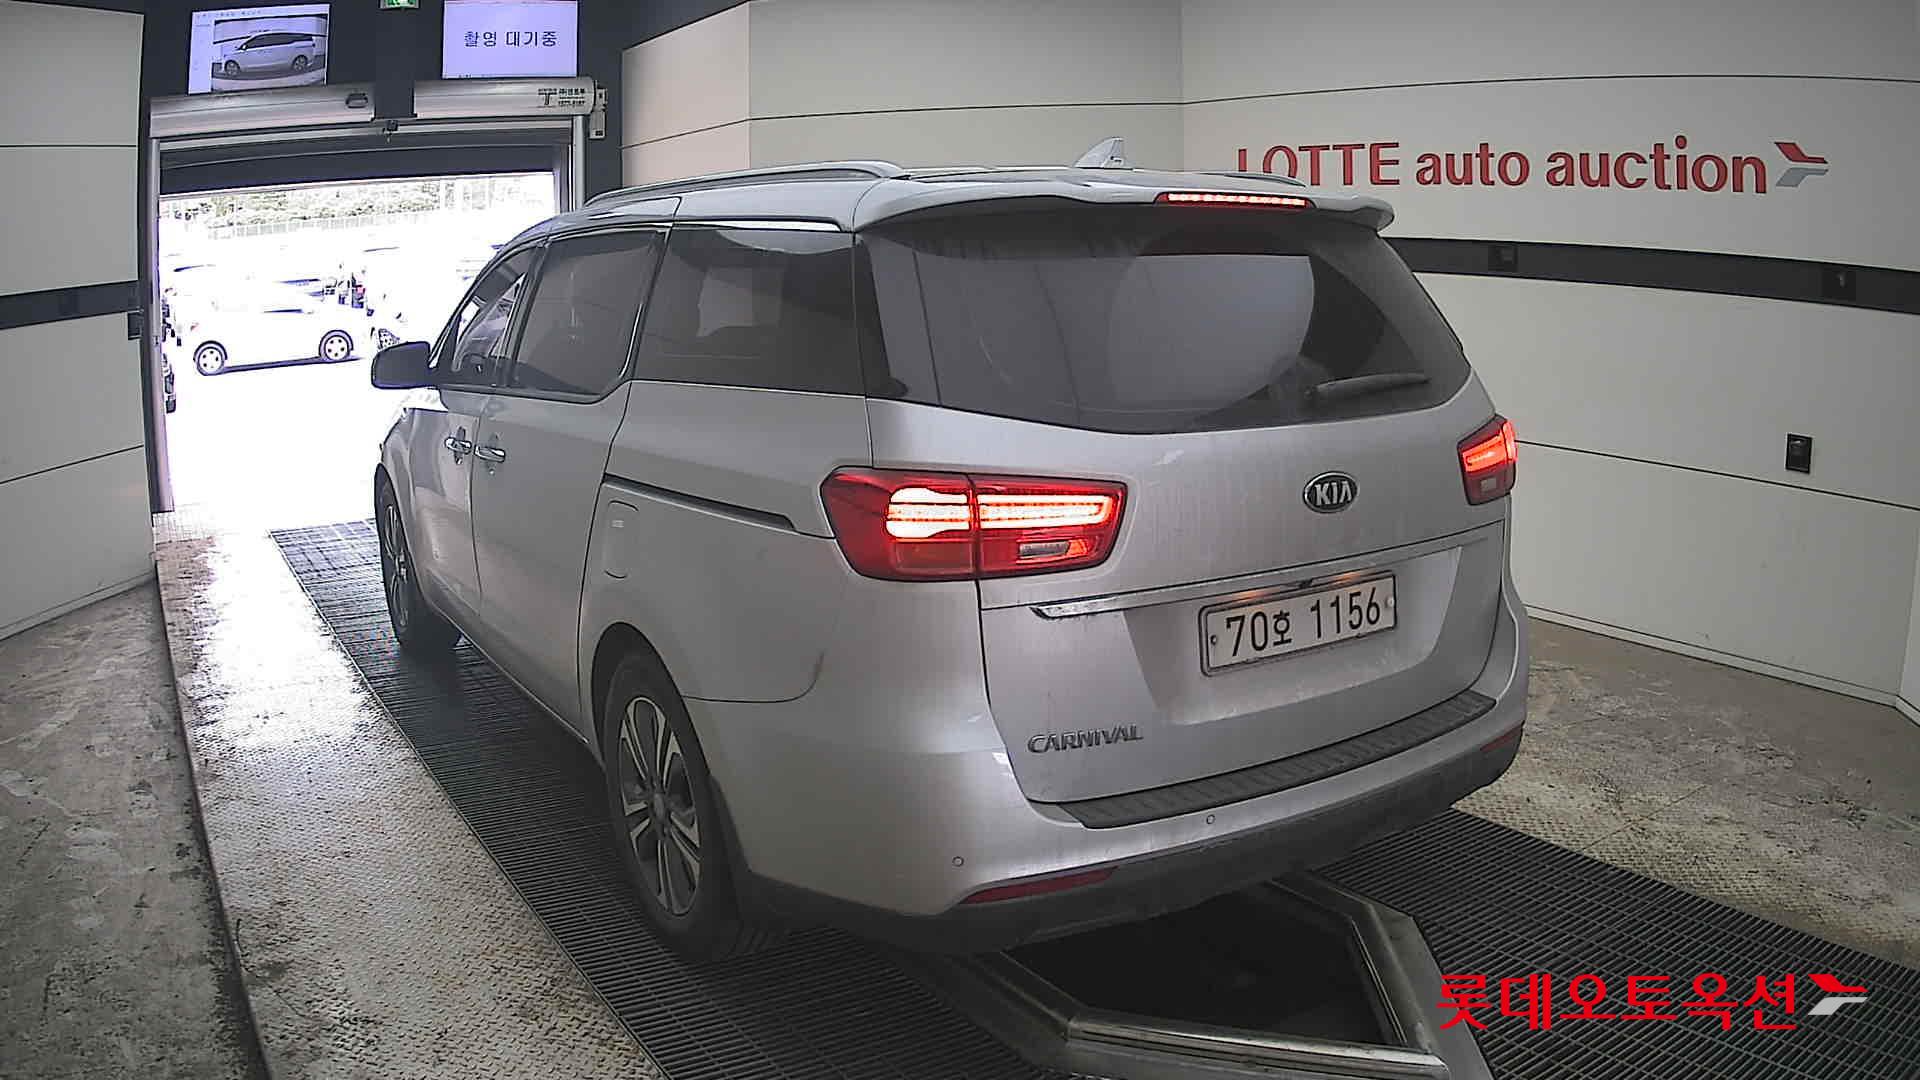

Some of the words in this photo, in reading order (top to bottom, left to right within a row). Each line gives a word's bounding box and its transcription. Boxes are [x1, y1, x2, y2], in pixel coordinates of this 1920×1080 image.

[464, 31, 497, 47] 촬영
[505, 31, 558, 47] 대기중
[1416, 142, 1530, 187] auto
[1546, 135, 1767, 194] auction
[1315, 480, 1352, 506] KIA
[1226, 610, 1292, 657] 70호
[1310, 587, 1381, 639] 1156
[1027, 724, 1144, 753] CARNIVAL
